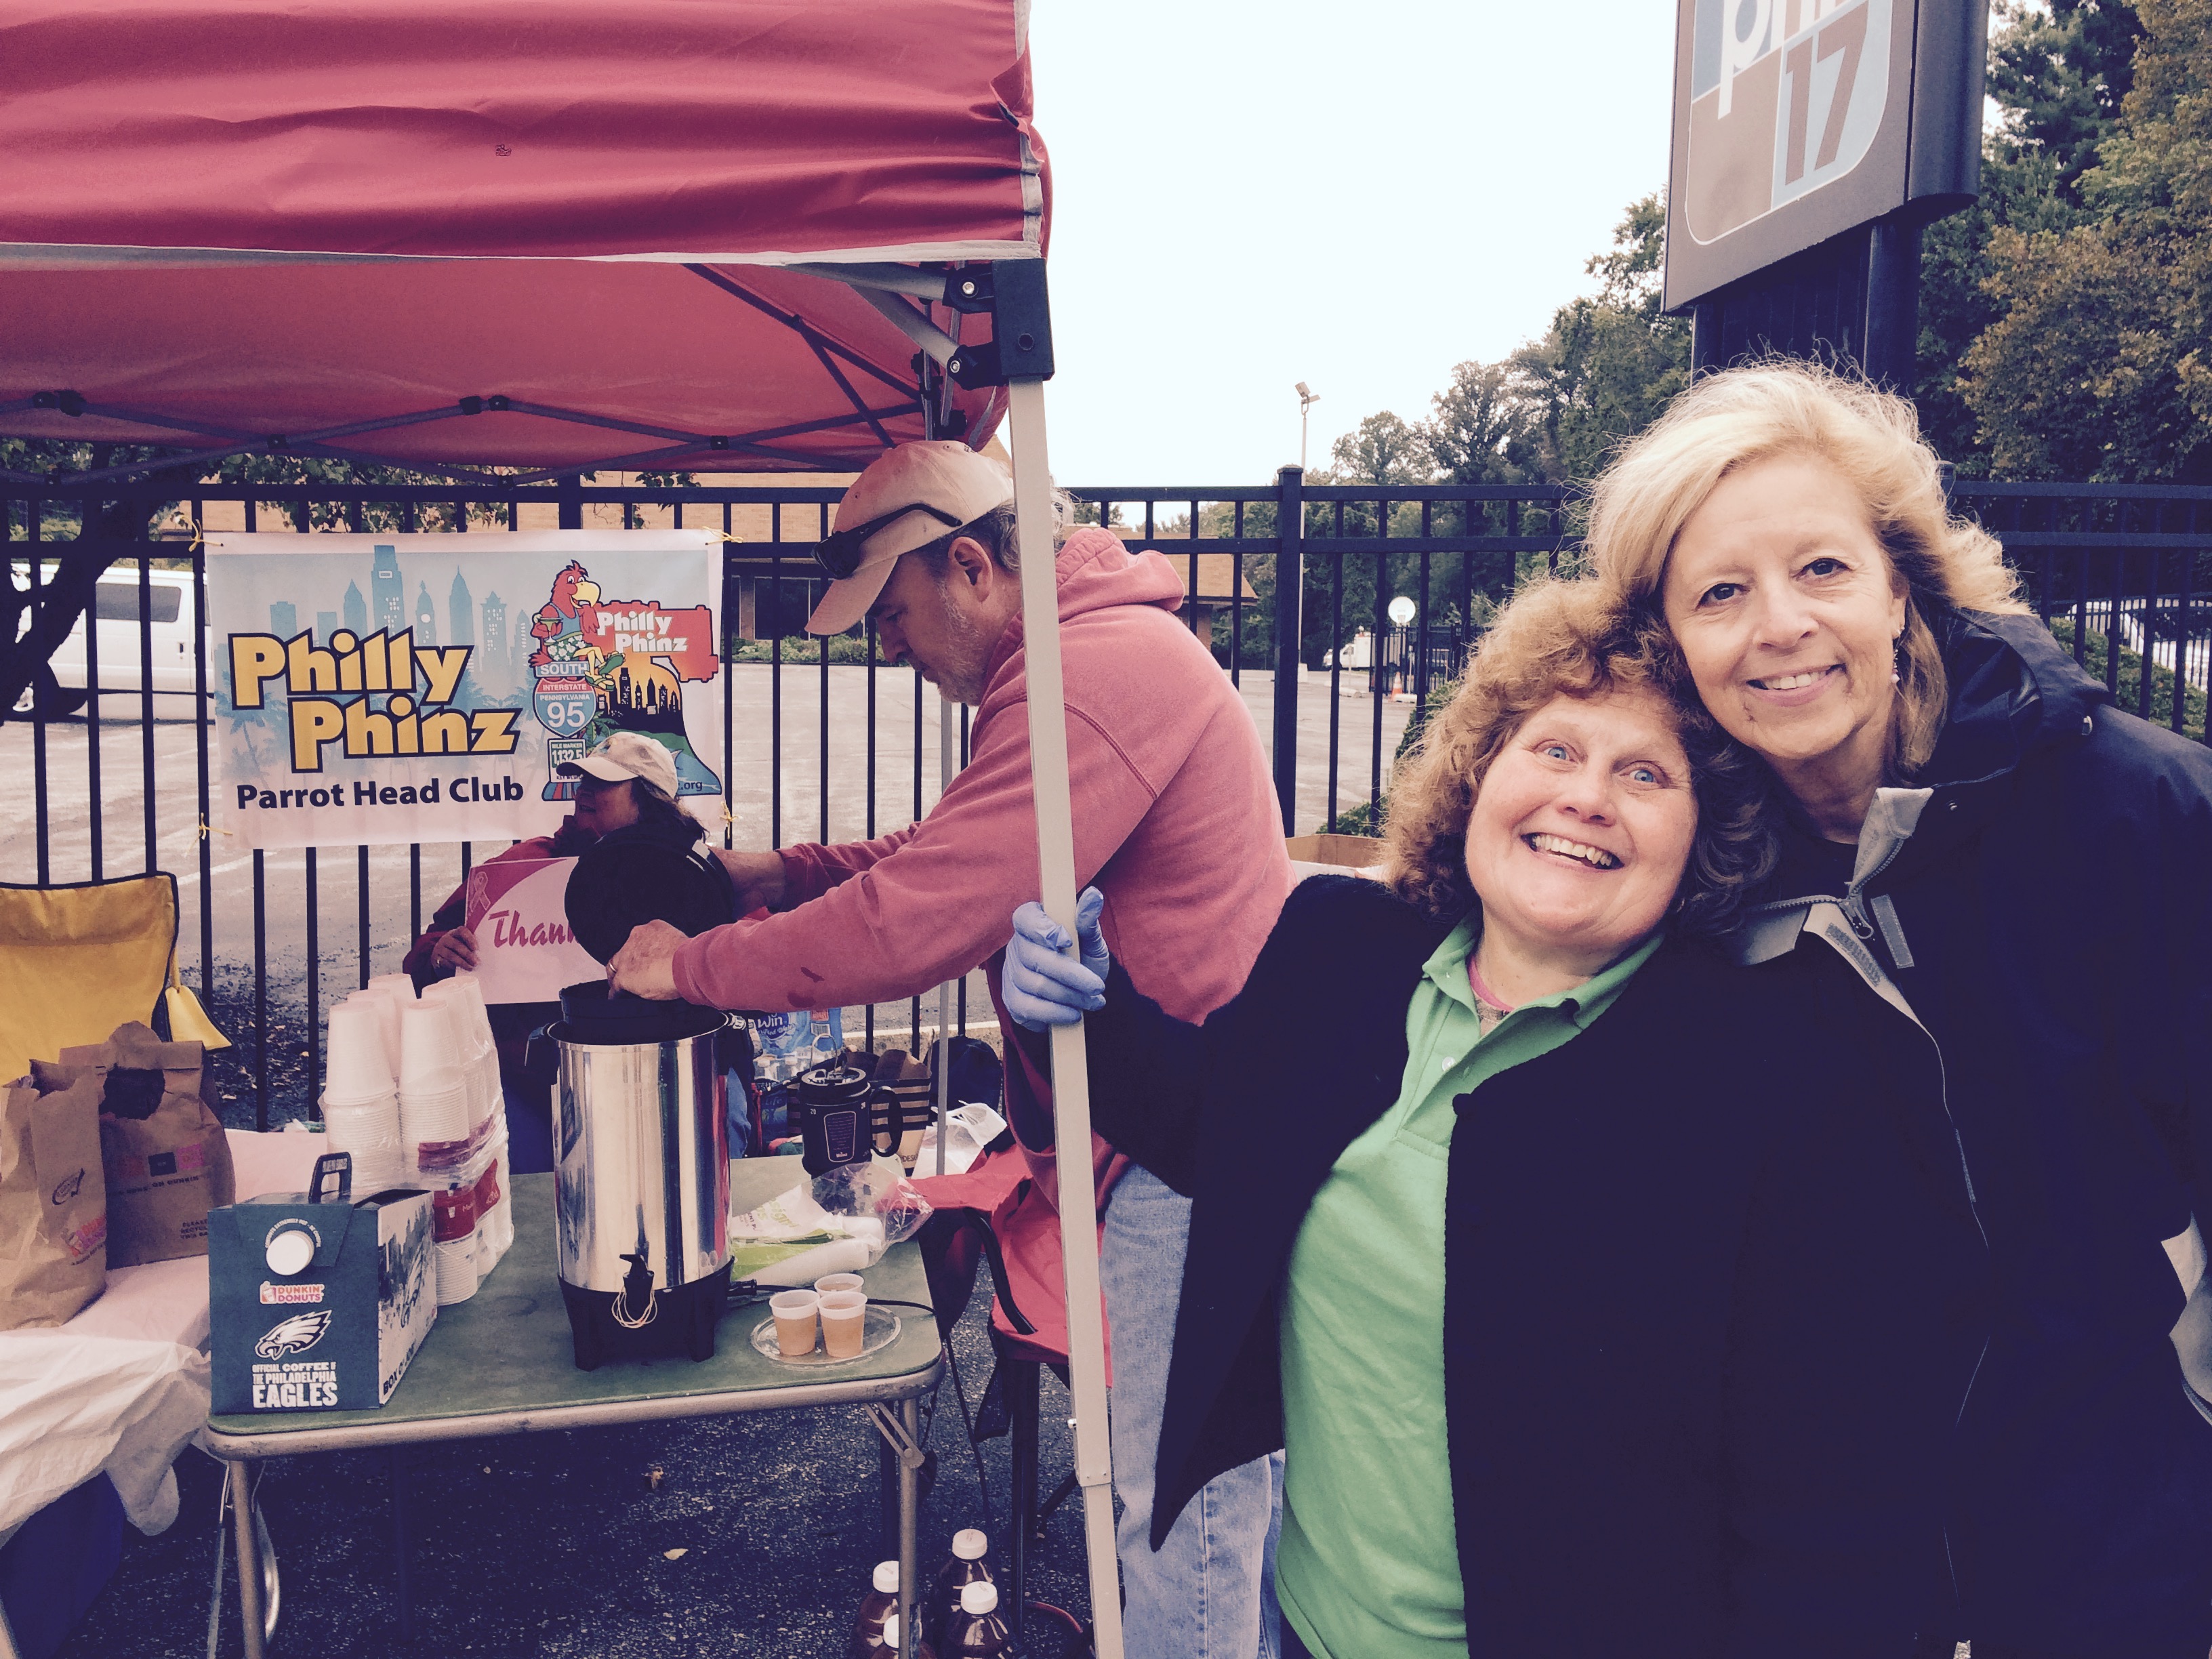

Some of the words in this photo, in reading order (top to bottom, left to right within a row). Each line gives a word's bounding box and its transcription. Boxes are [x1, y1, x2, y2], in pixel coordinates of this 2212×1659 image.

[1785, 1, 1869, 185] 17
[596, 611, 672, 635] Philly
[615, 632, 688, 653] Phinz
[228, 626, 474, 710] Philly
[540, 663, 588, 676] SOUTH
[543, 683, 587, 691] INTERSTATE
[547, 702, 586, 728] 95
[287, 693, 523, 773] Phinz
[237, 784, 344, 810] Parrot
[353, 777, 440, 804] Head
[449, 775, 524, 802] Club
[678, 780, 703, 792] .org
[279, 1293, 321, 1303] DONUTS
[251, 1364, 280, 1373] OFFICIAL
[282, 1363, 329, 1372] COFFEE
[253, 1373, 264, 1385] THE
[265, 1370, 337, 1385] PHILADELPHIA
[252, 1382, 339, 1409] EAGLES
